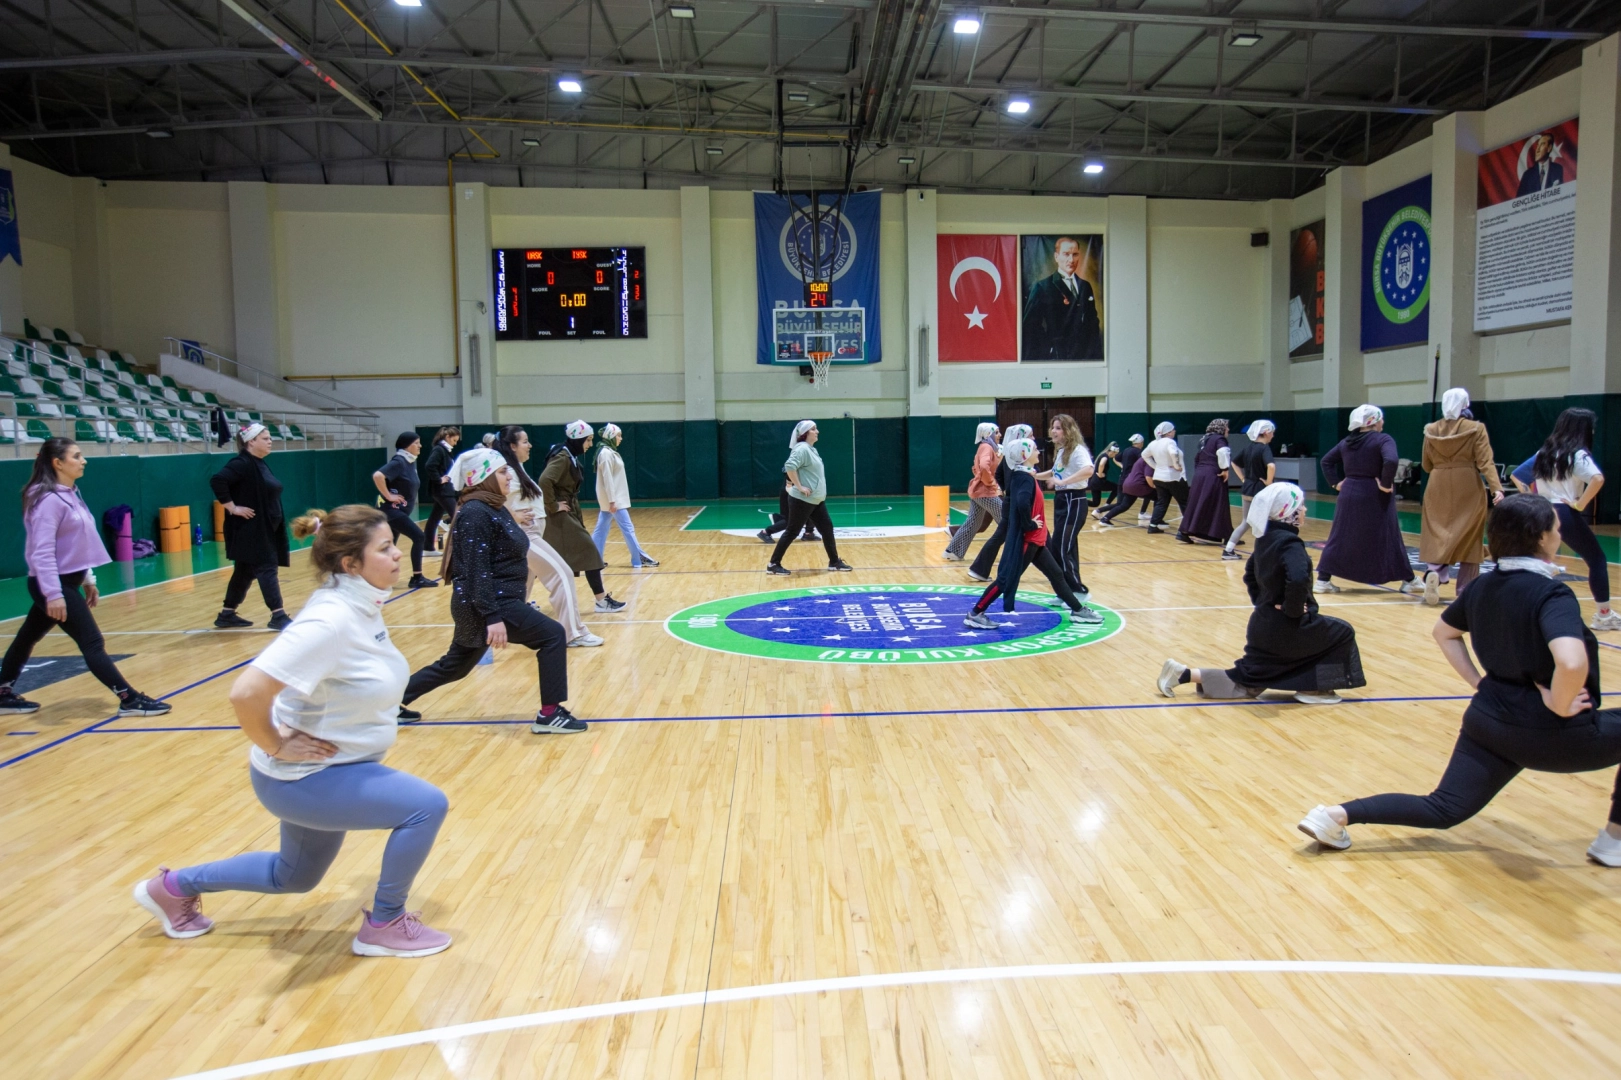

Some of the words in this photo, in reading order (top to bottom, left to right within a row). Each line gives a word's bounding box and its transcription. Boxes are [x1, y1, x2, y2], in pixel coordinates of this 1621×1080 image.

[1511, 193, 1540, 208] GENÇLİĞE
[1540, 187, 1561, 200] HİTABE
[810, 292, 826, 307] 24
[808, 585, 906, 594] BURSA
[897, 602, 947, 631] BURSA
[817, 648, 986, 662] KULÜBÜ
